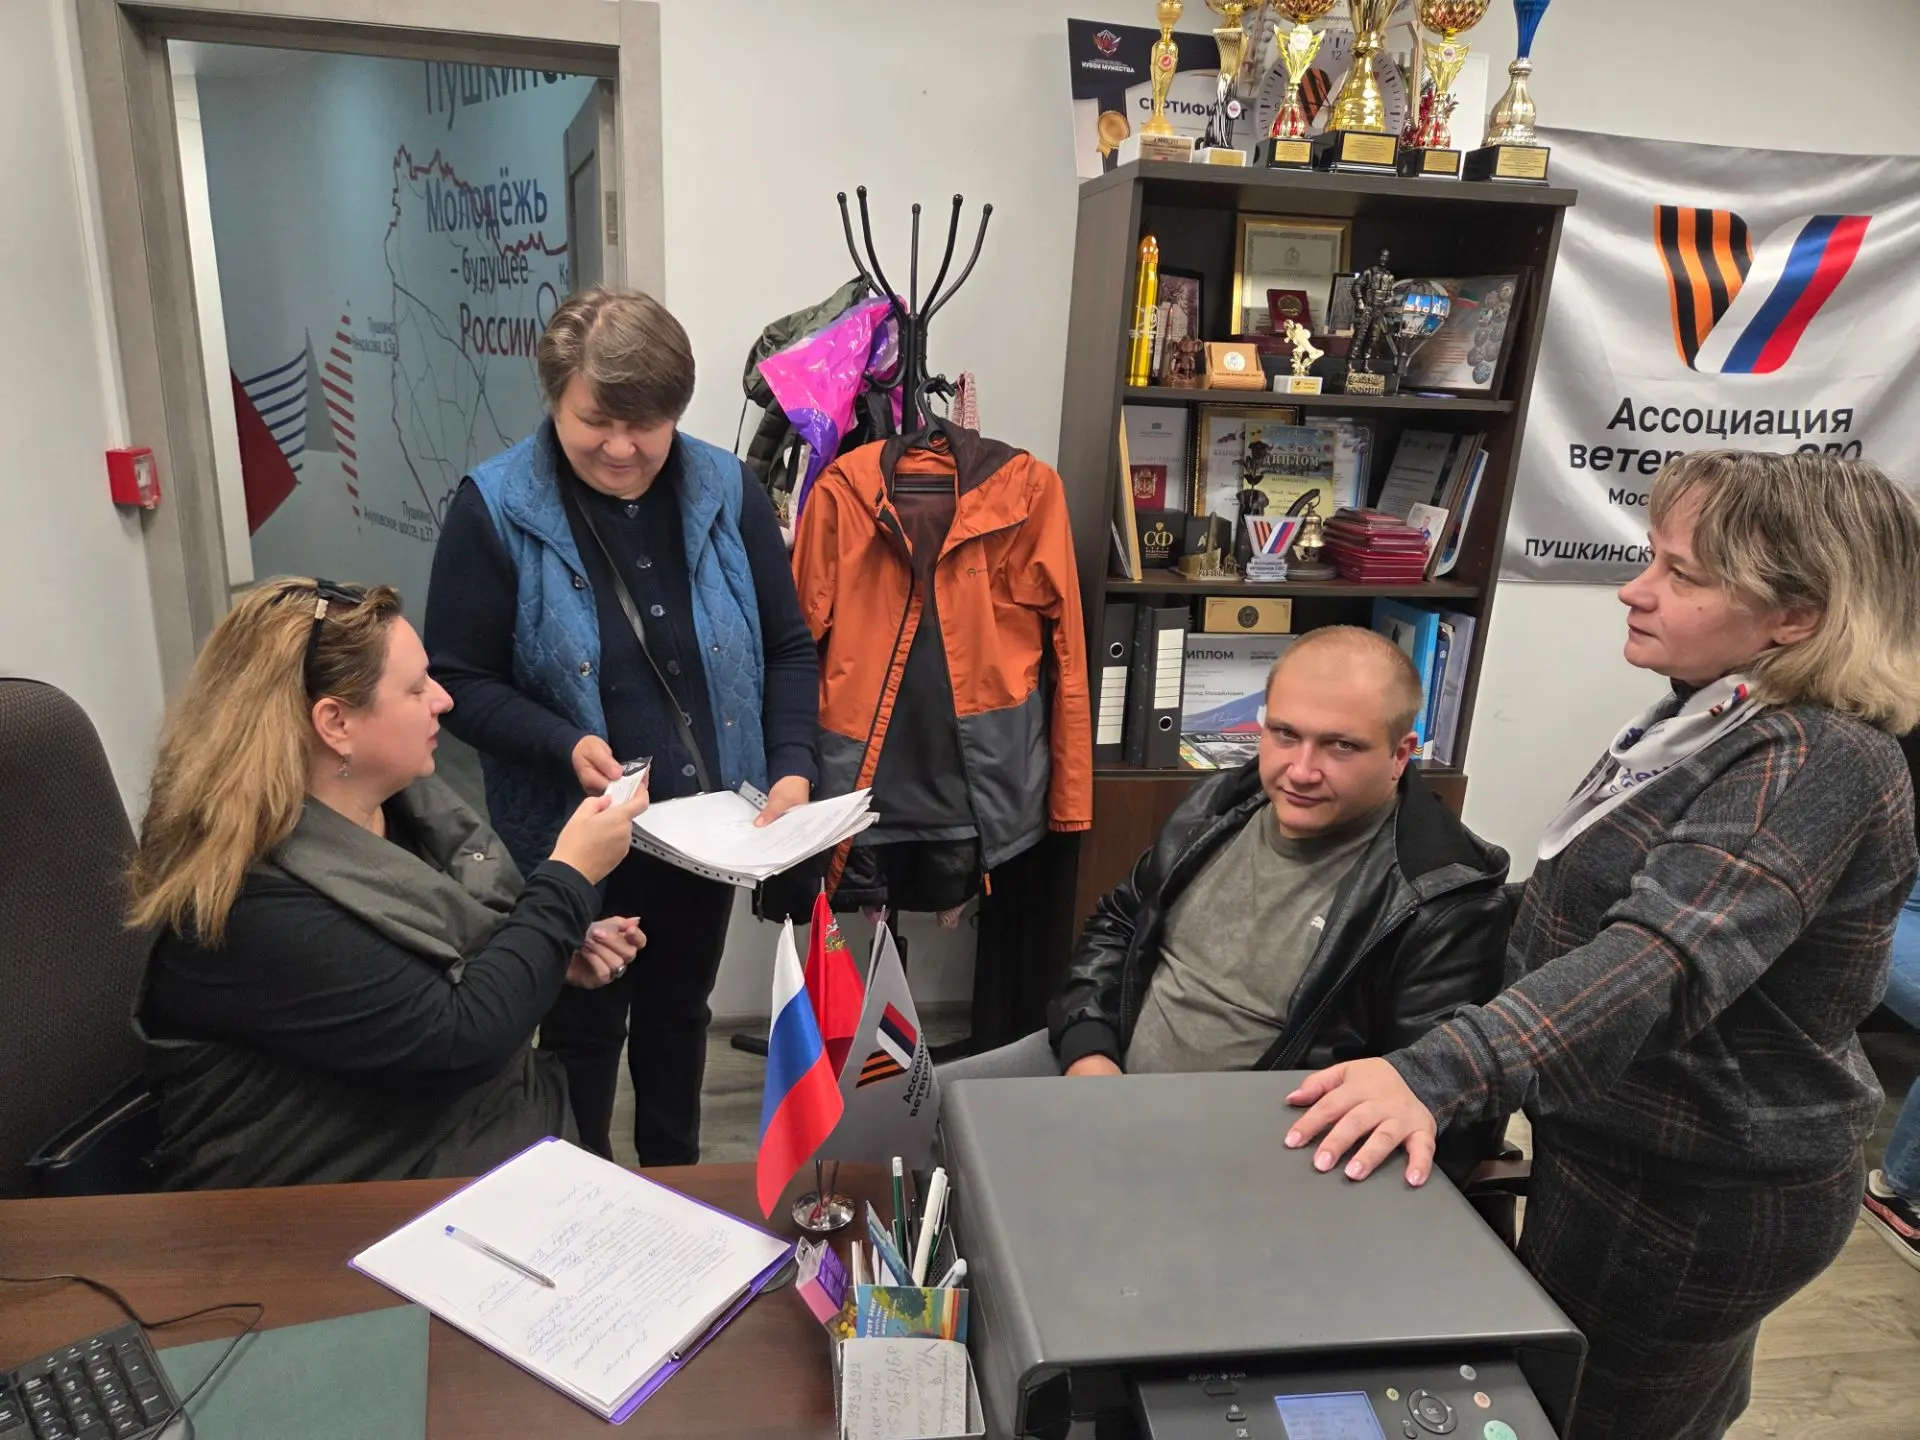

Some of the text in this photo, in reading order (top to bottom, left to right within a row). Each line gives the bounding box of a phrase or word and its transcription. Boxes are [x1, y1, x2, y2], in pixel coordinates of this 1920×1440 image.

[1332, 51, 1342, 60] 12
[425, 167, 547, 240] Молодёжь
[462, 248, 528, 294] будущее
[460, 302, 537, 357] России
[1607, 397, 1854, 440] Ассоциация
[1262, 454, 1319, 468] ДИПЛОМ
[1143, 530, 1174, 547] СФ
